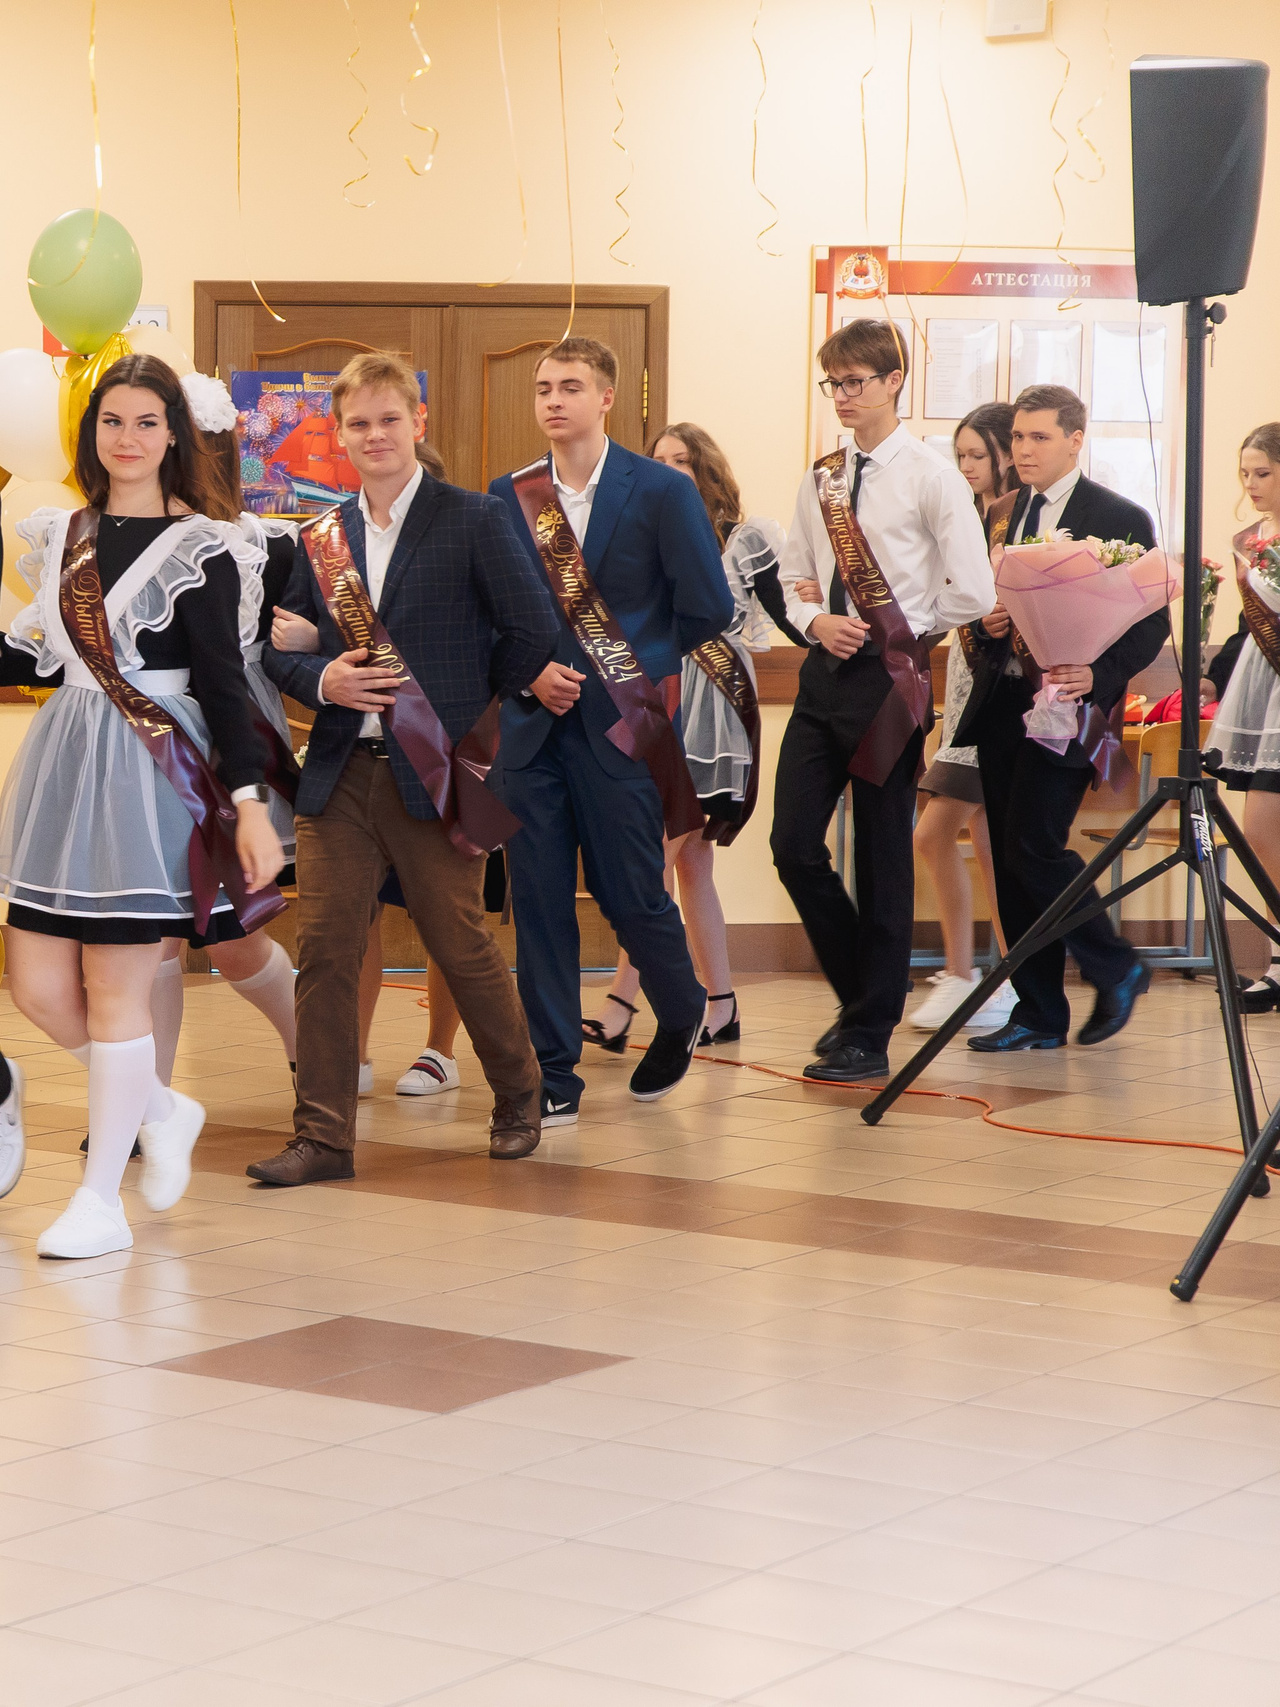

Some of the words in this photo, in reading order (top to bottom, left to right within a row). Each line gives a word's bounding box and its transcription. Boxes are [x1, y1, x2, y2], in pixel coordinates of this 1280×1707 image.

[971, 272, 1092, 289] АТТЕСТАЦИЯ
[321, 539, 374, 650] Выпускник
[827, 473, 865, 574] Выпускник
[854, 567, 893, 608] 2024
[549, 534, 611, 646] Выпускник
[597, 639, 643, 684] 2024
